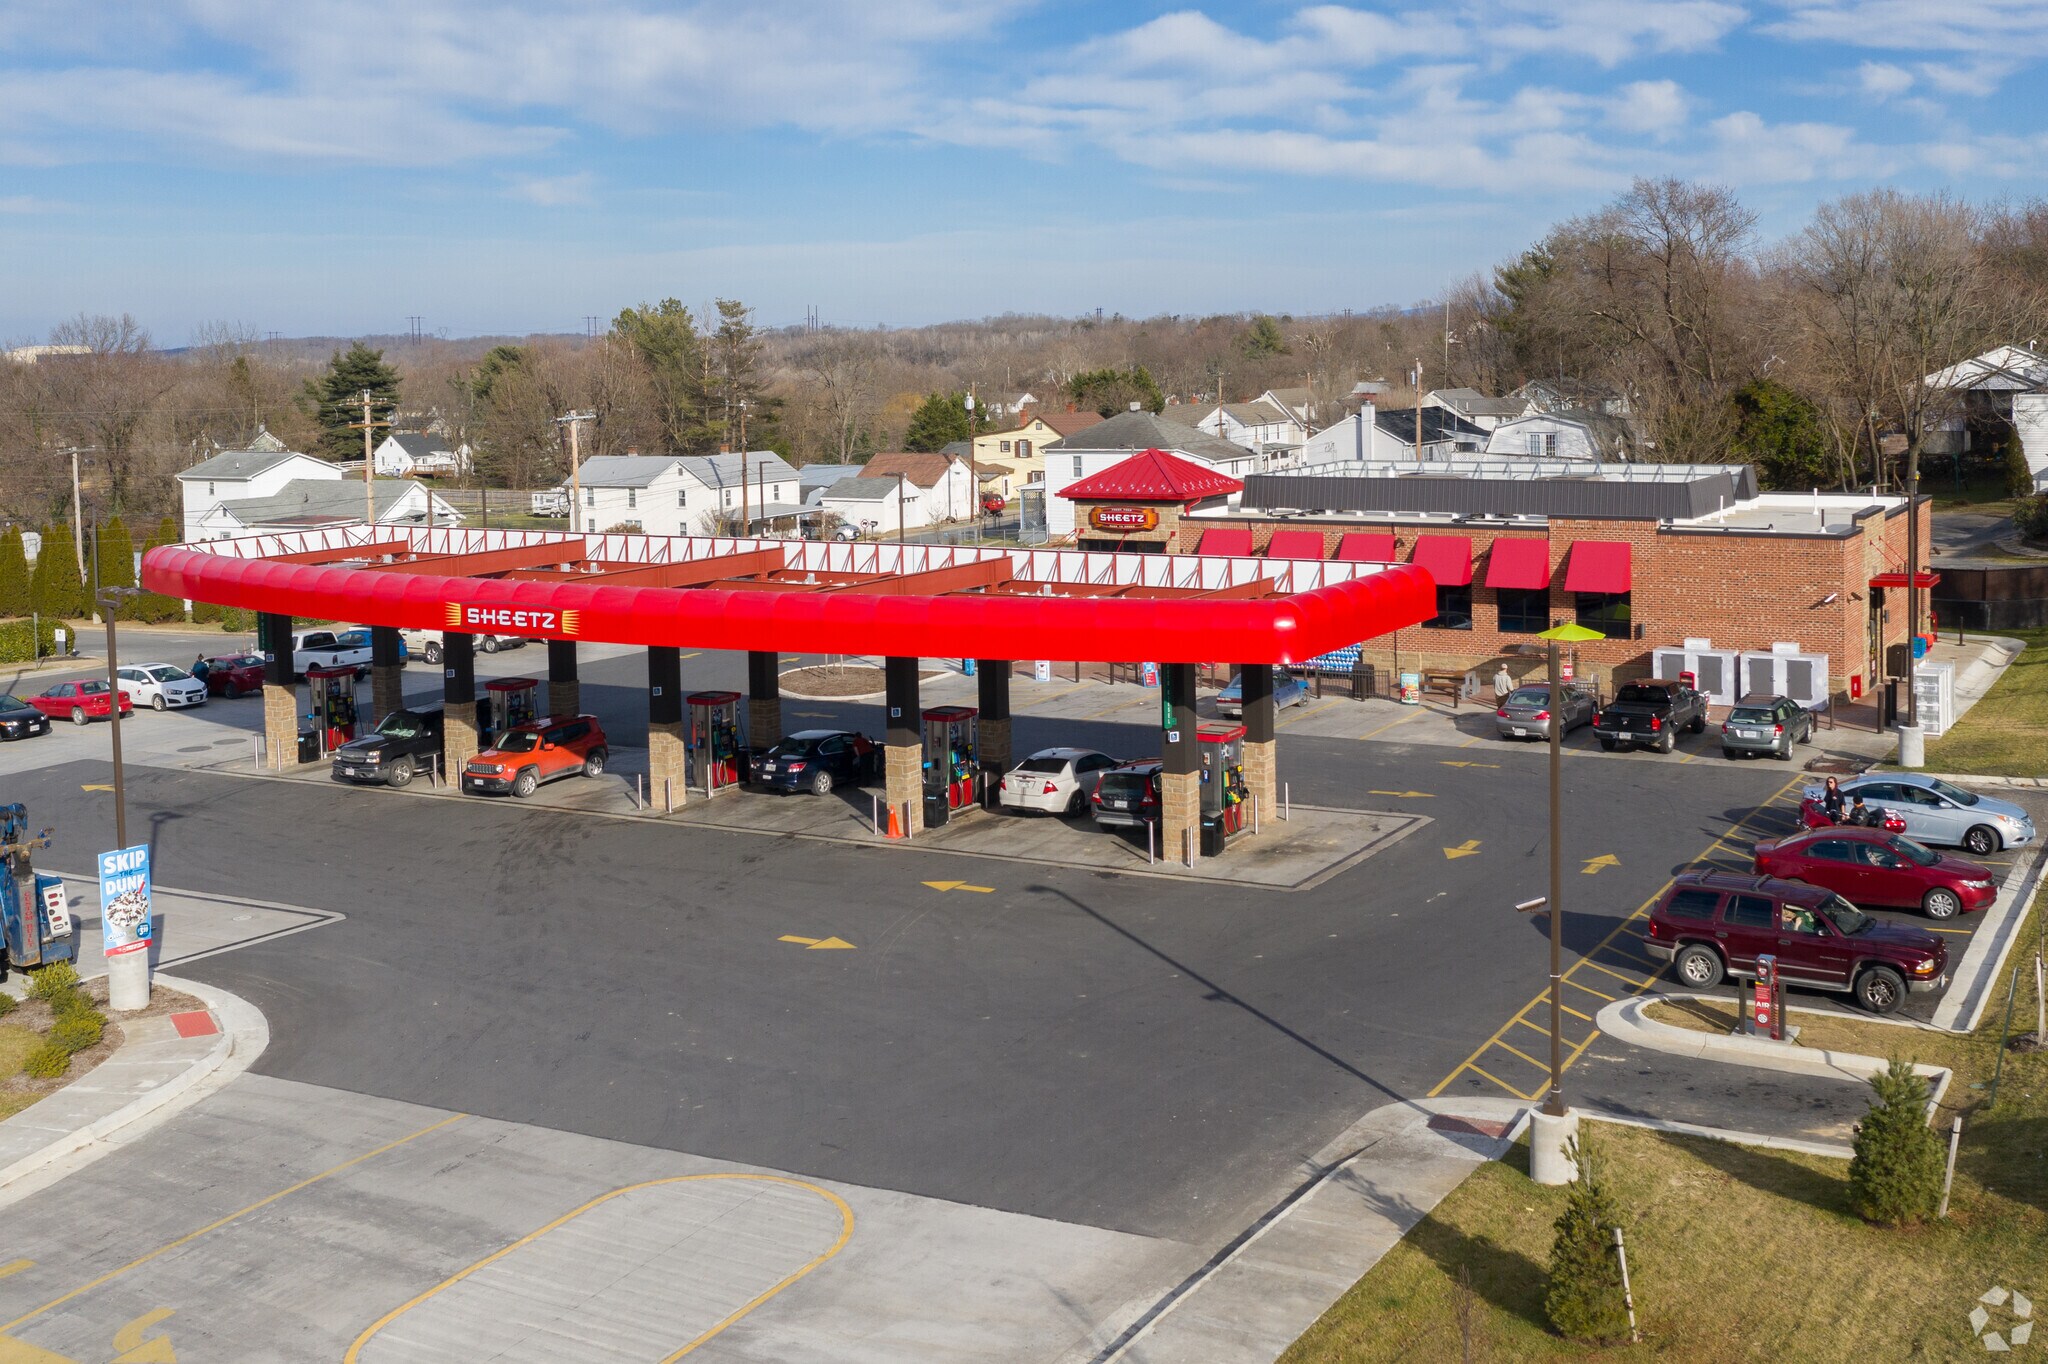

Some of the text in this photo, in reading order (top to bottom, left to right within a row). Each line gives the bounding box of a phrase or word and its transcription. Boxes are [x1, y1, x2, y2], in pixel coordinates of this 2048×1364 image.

[1100, 513, 1145, 523] SHEETZ
[467, 607, 555, 629] SHEETZ
[103, 849, 146, 874] SKIP
[105, 873, 146, 896] DUNK
[1755, 1001, 1770, 1009] AIR
